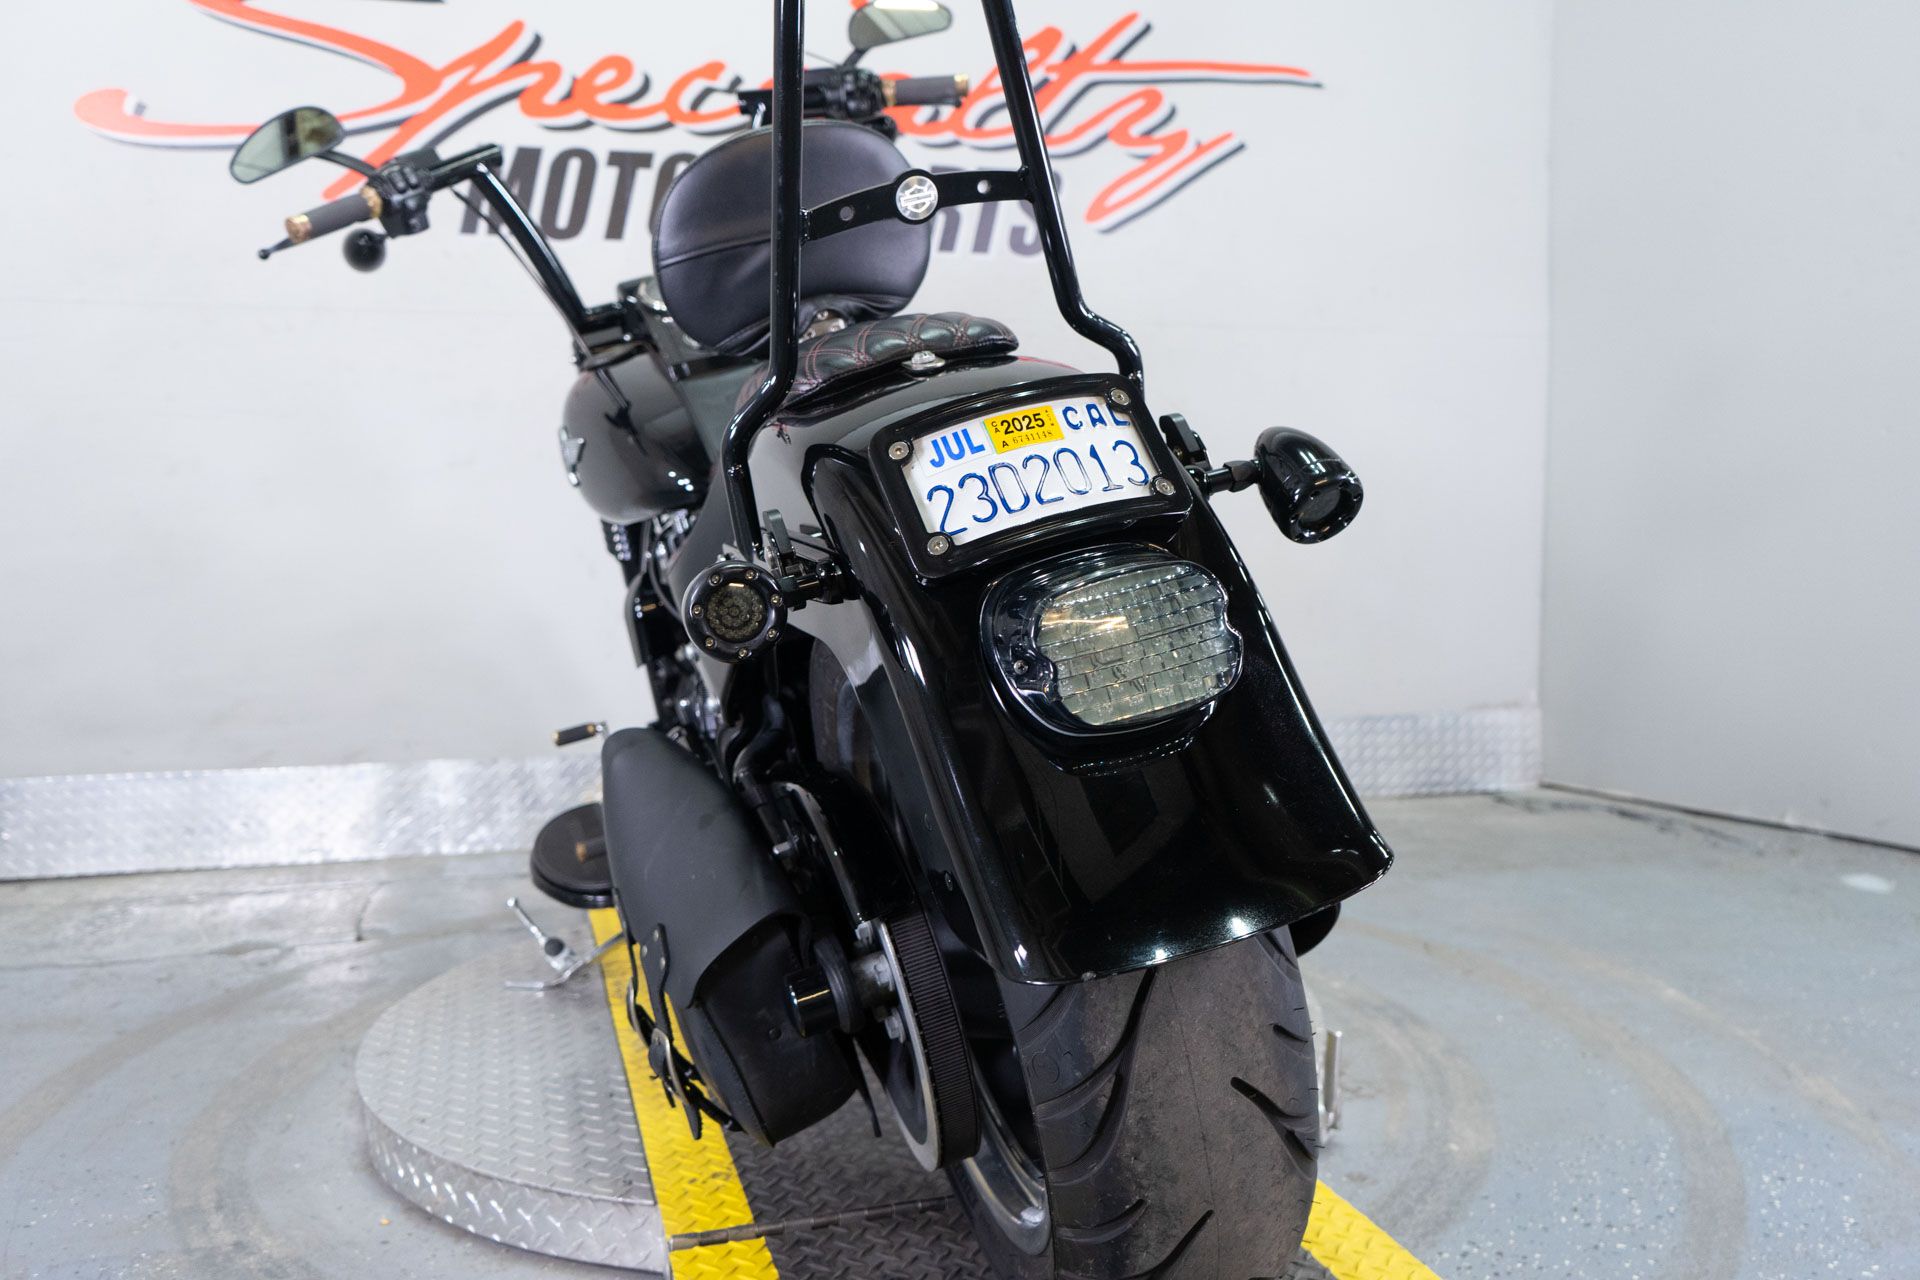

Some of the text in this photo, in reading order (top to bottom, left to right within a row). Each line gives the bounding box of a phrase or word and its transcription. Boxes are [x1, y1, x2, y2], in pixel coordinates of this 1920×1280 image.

[1000, 413, 1045, 435] 2025
[1062, 402, 1131, 430] CAL
[930, 428, 986, 468] JUL
